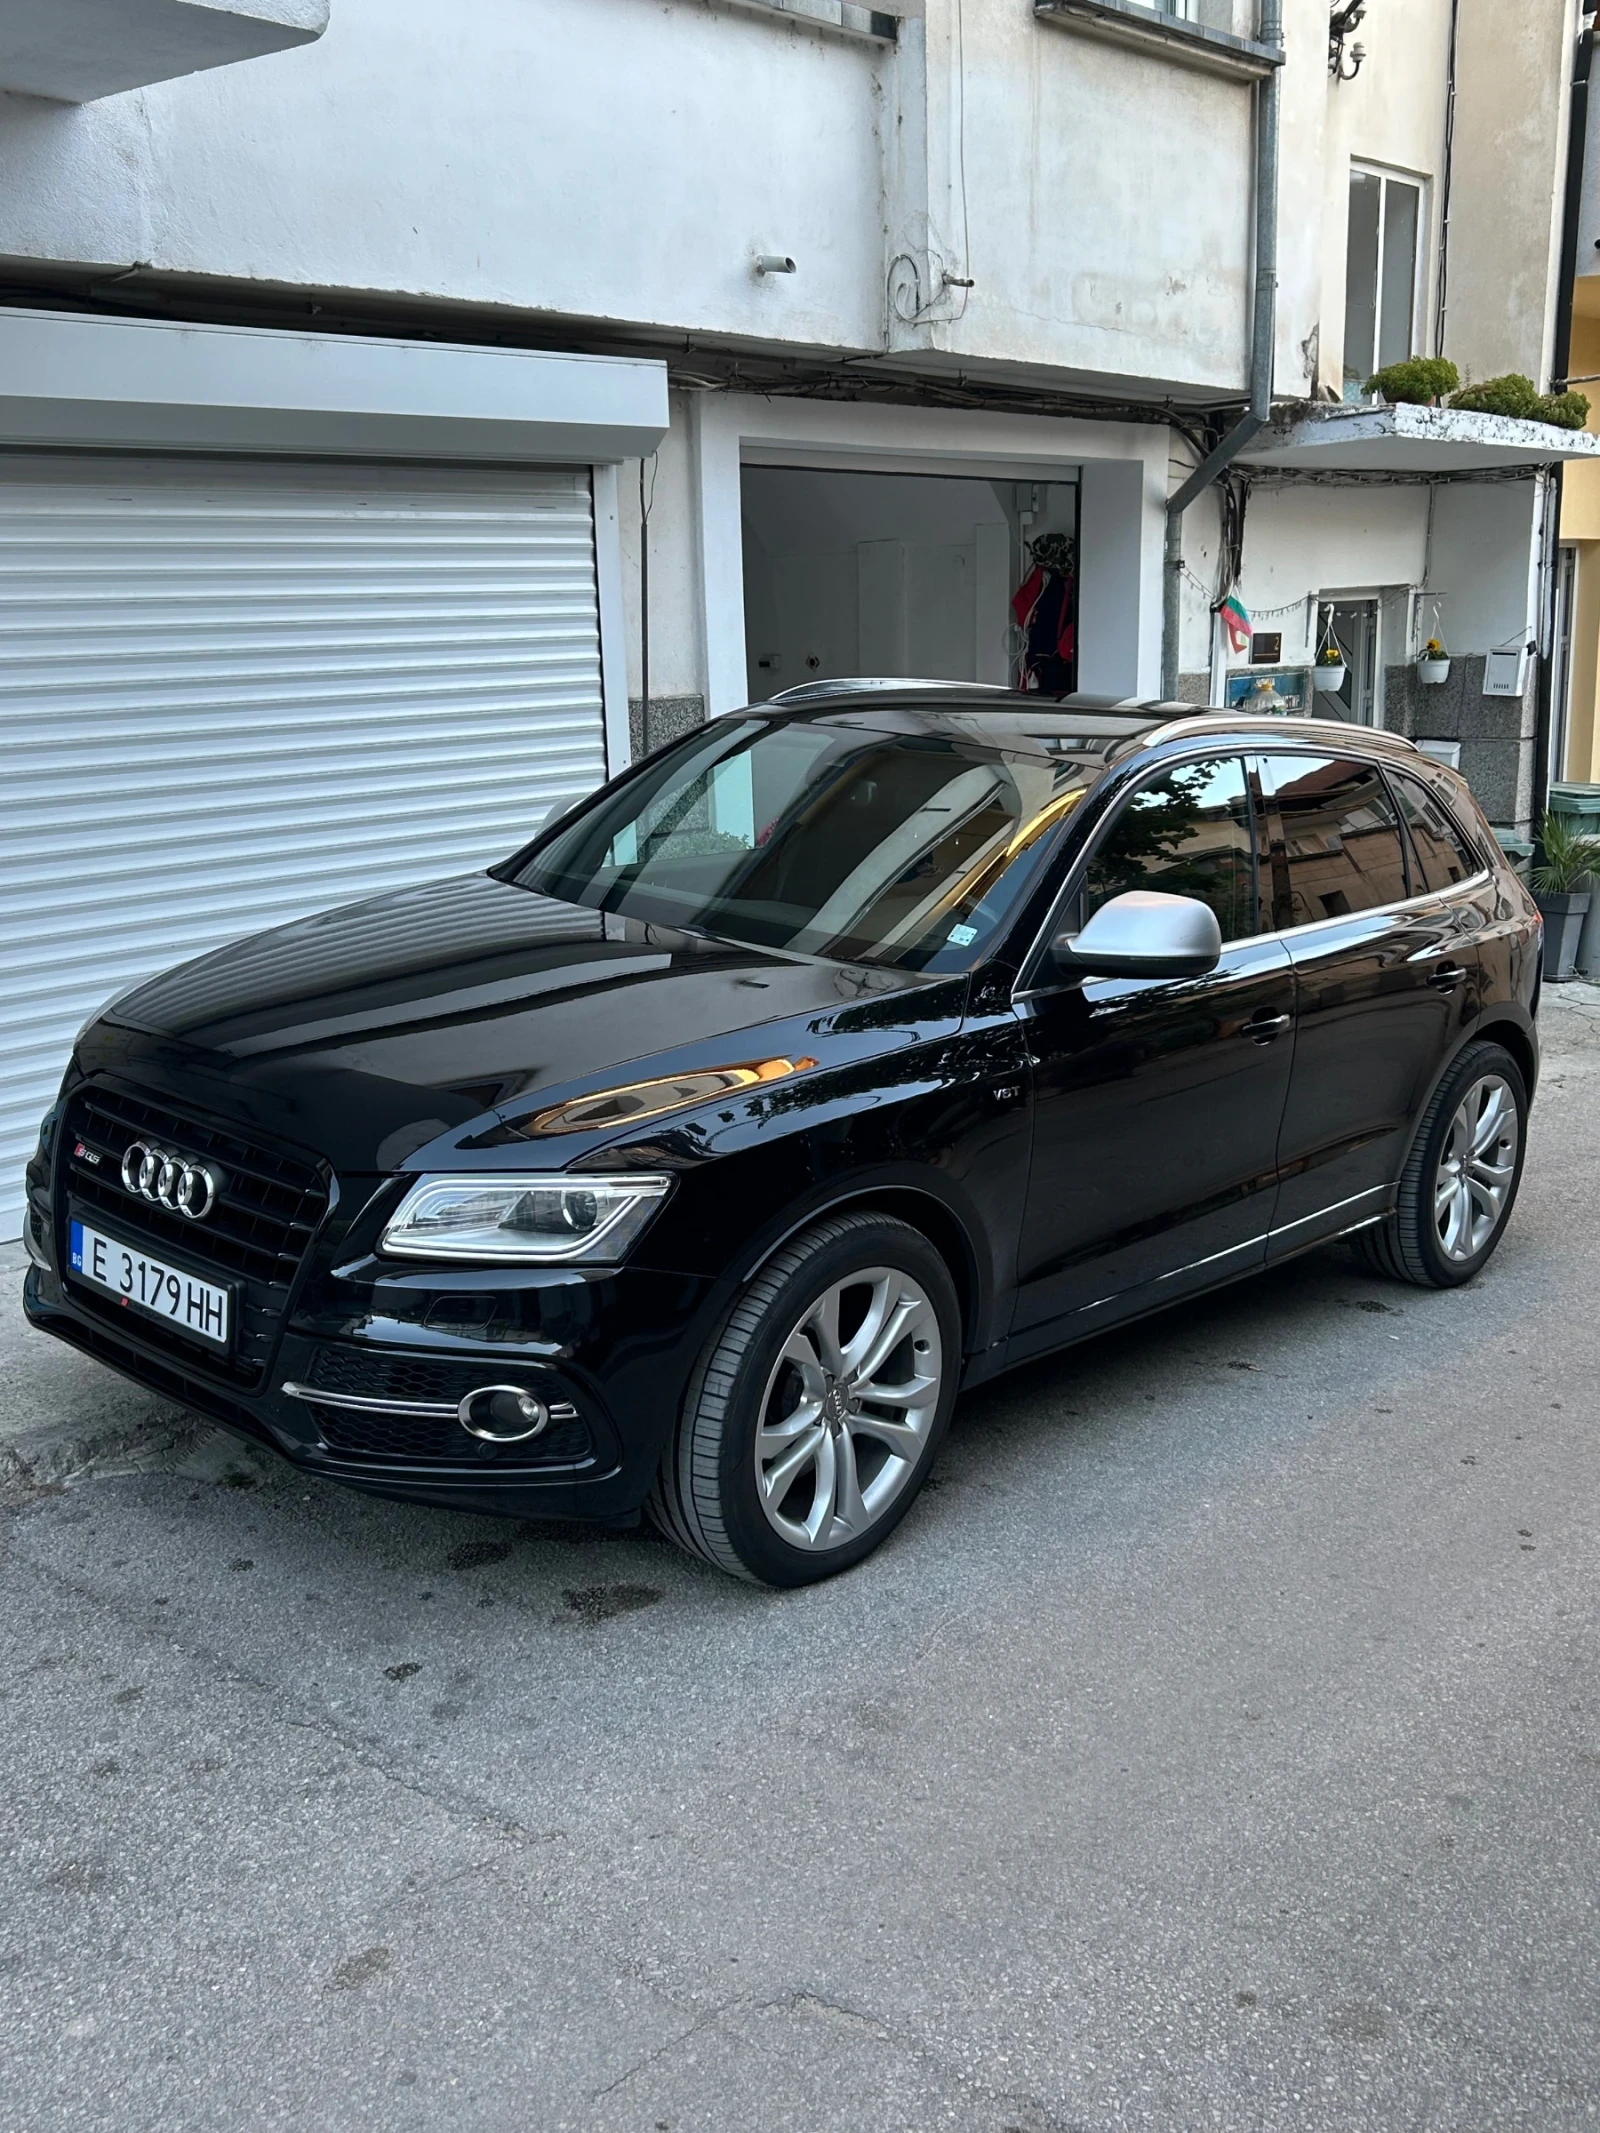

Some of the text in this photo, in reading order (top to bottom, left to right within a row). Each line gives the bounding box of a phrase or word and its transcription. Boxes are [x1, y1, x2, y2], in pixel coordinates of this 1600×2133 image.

[1274, 636, 1280, 651] 2
[72, 1252, 82, 1267] BG
[93, 1237, 107, 1282] E
